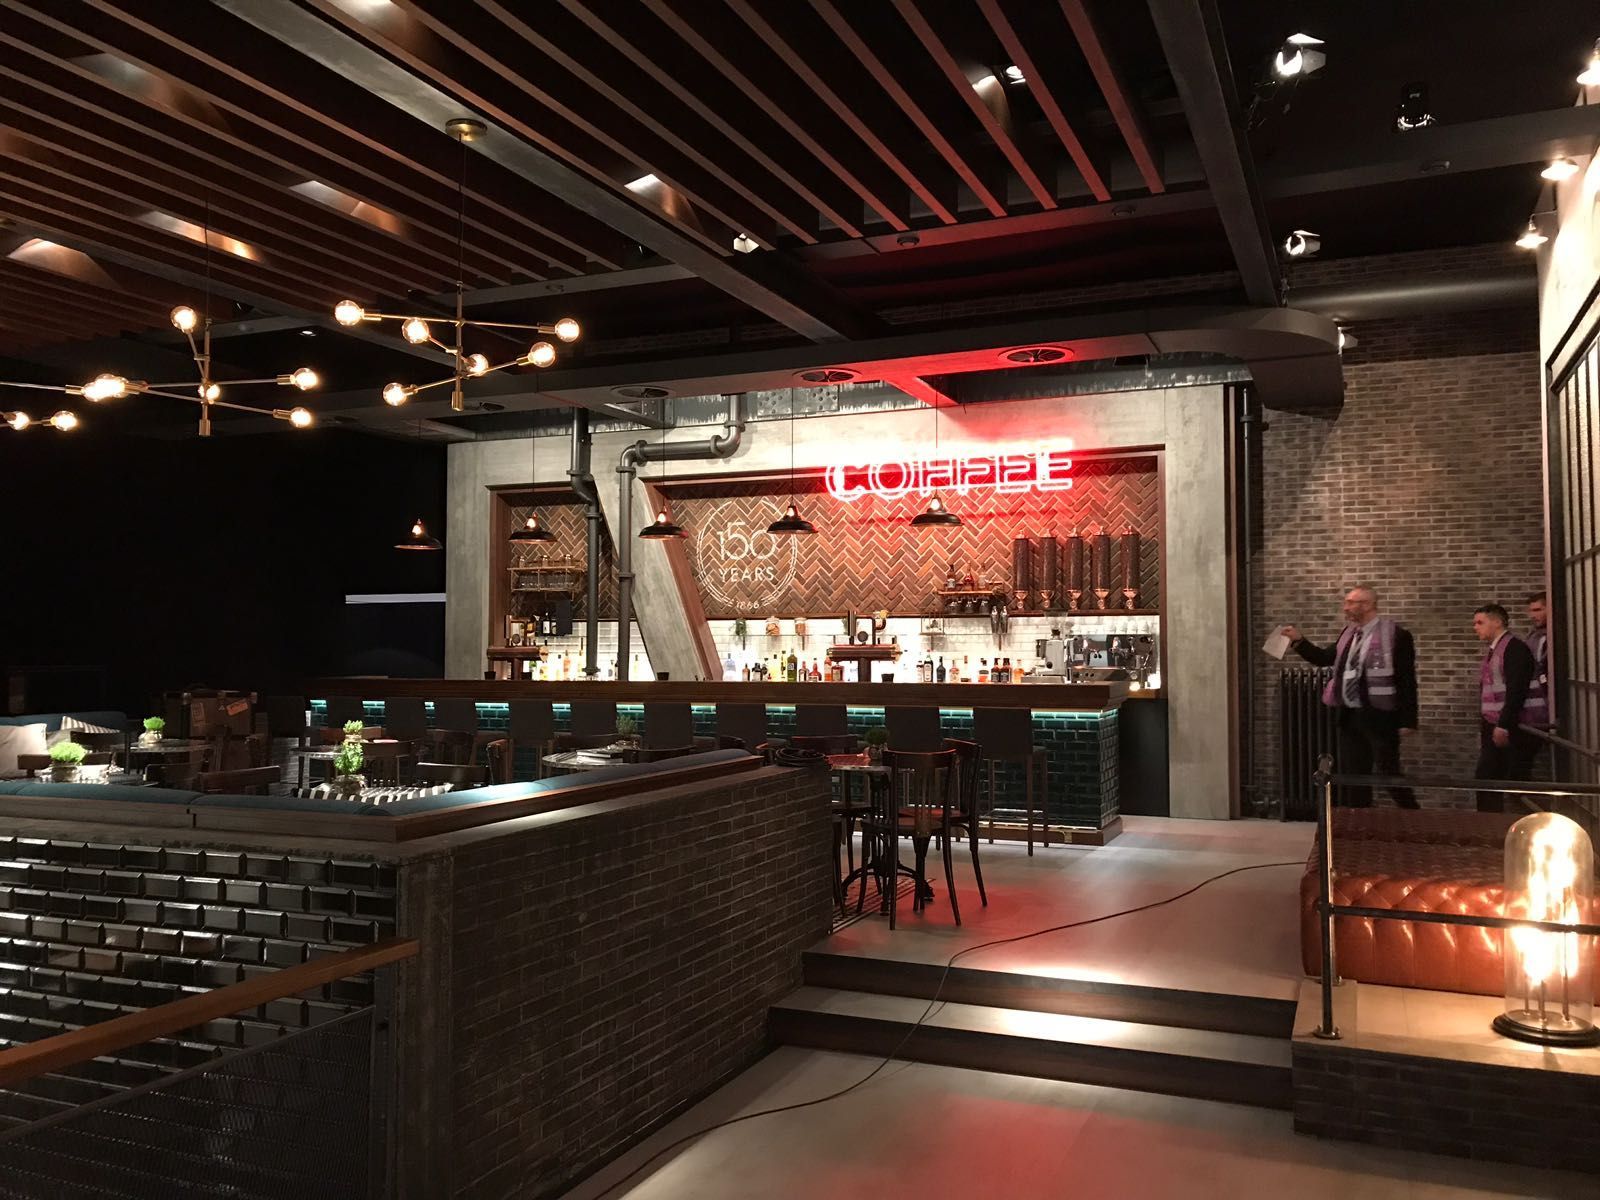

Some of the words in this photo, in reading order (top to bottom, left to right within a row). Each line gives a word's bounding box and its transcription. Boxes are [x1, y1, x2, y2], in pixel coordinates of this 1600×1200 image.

[825, 438, 1073, 502] COFFEE
[717, 521, 776, 560] 150
[718, 566, 774, 582] YEARS
[736, 601, 760, 610] 1866
